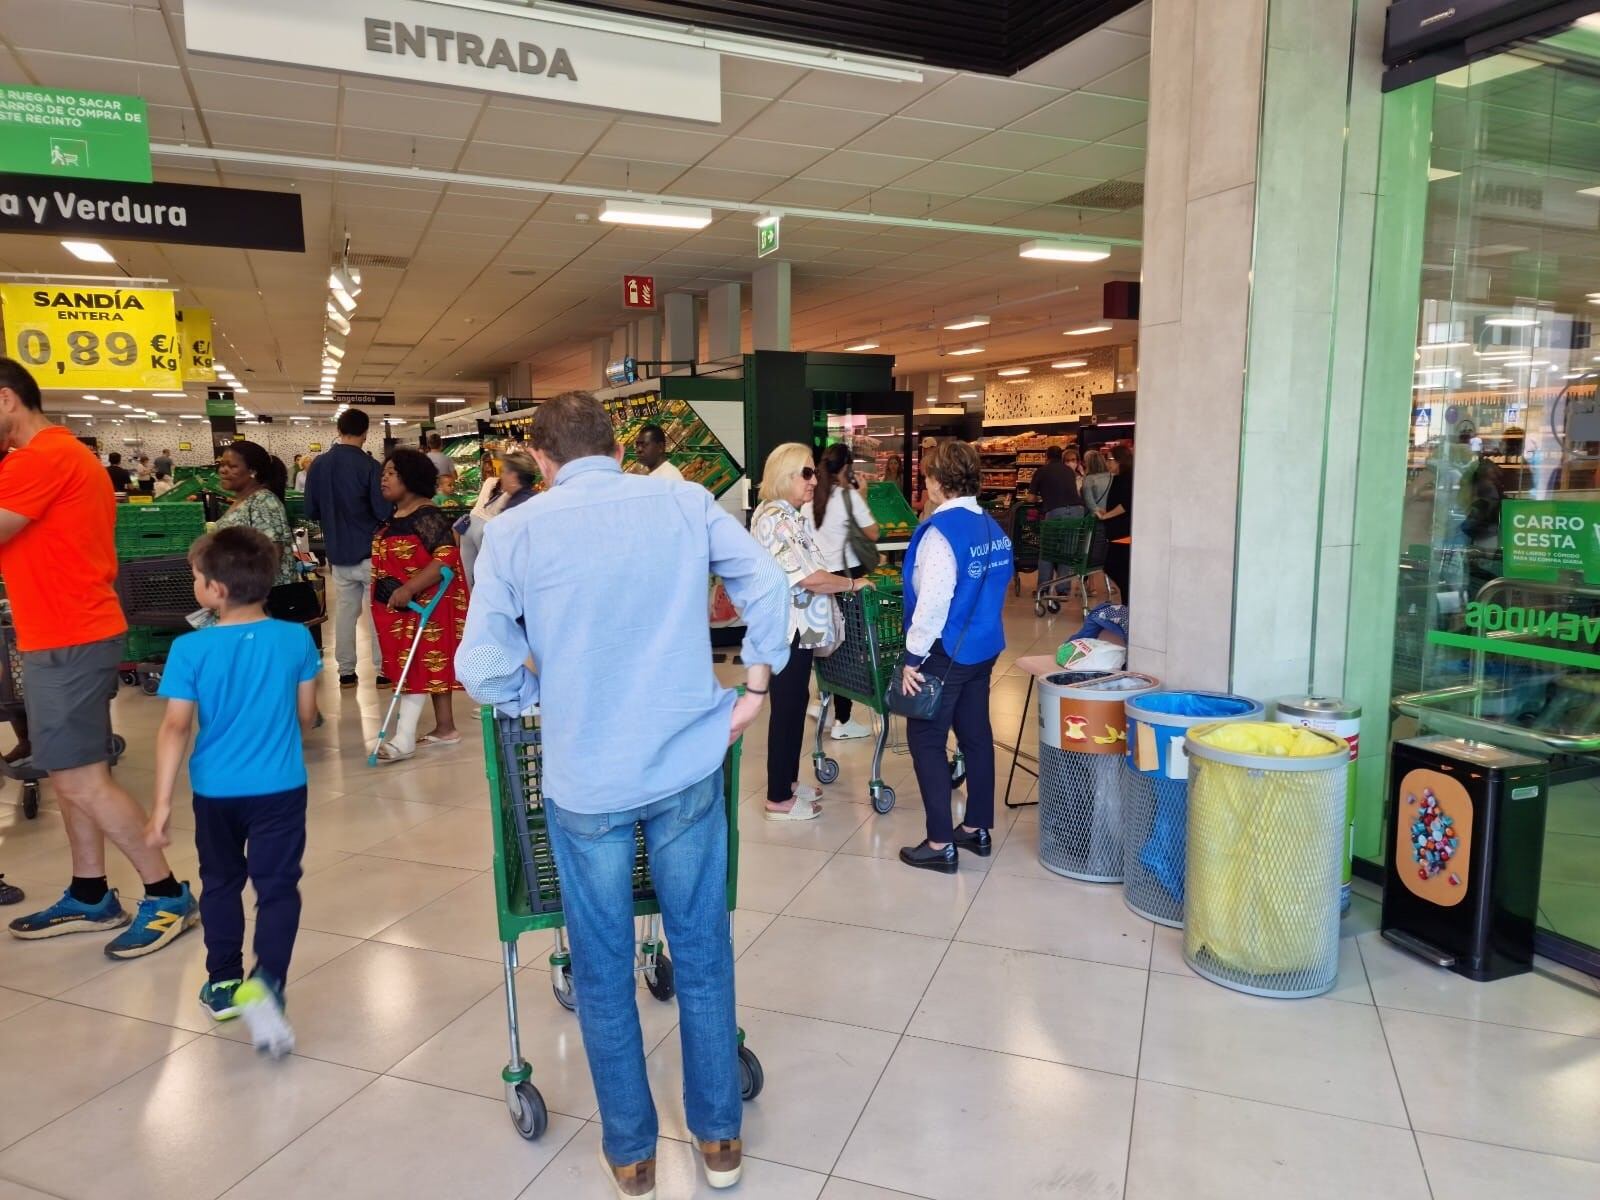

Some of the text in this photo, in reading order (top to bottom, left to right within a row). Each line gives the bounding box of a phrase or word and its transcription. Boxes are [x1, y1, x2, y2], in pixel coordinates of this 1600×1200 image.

[364, 17, 578, 81] ENTRADA
[8, 90, 53, 104] RUEGA
[56, 95, 76, 106] NO
[79, 98, 122, 111] SACAR
[26, 113, 82, 128] RECINTO
[47, 105, 64, 115] DE
[67, 107, 122, 121] COMPRA
[125, 113, 142, 123] DE
[0, 191, 187, 227] a y Verdura
[33, 290, 144, 310] SANDÍA
[58, 310, 124, 321] ENTERA
[17, 329, 138, 374] 0,89
[151, 356, 177, 371] Kg
[193, 355, 213, 368] Kg
[1513, 514, 1585, 531] CARRO
[1513, 532, 1576, 549] CESTA
